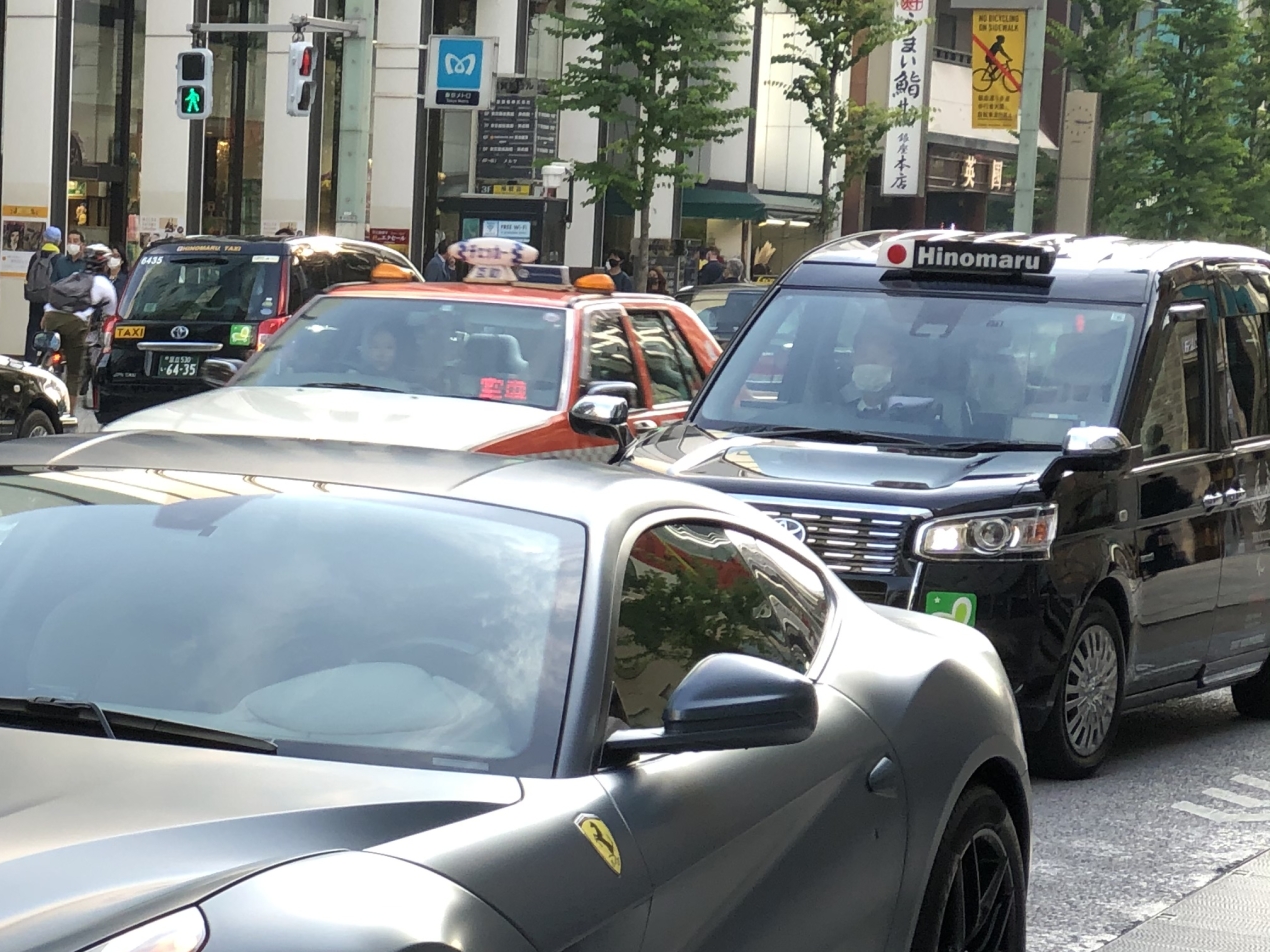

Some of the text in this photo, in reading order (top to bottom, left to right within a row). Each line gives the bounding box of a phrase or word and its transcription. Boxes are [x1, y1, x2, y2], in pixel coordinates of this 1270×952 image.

[988, 15, 1019, 23] BICYCLING
[988, 24, 1019, 32] SIDEWALK
[140, 255, 164, 265] 6435
[917, 246, 1040, 270] Hinomaru
[116, 327, 145, 338] TAXI
[166, 363, 197, 376] 64-35
